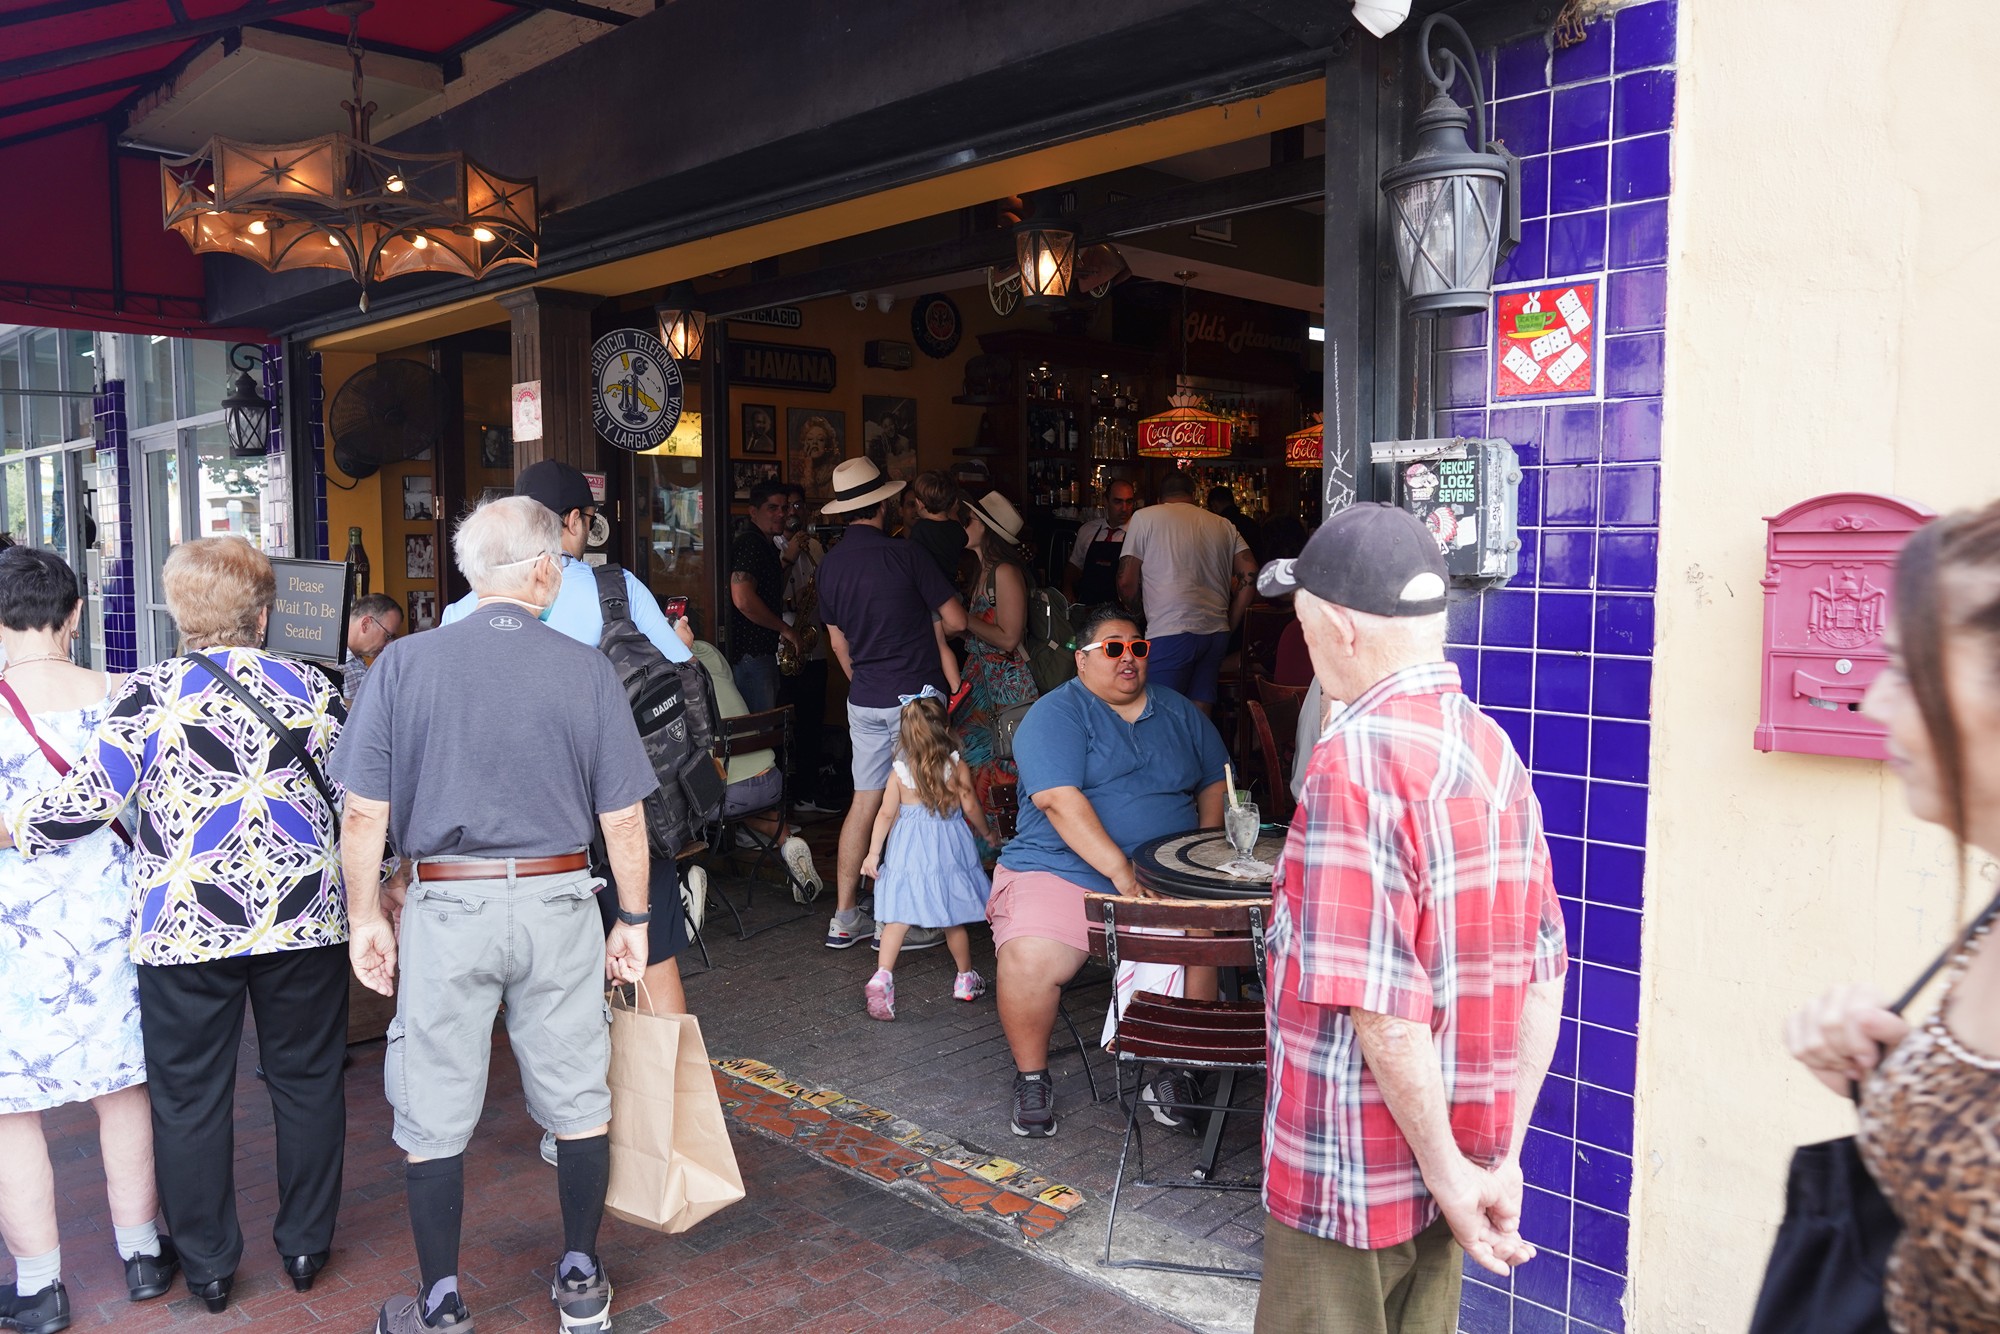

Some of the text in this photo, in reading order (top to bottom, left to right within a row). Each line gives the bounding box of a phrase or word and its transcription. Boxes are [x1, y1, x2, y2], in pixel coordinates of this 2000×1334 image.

[591, 333, 680, 386] SERVICIO TELEFONICO
[744, 349, 833, 384] HAVANA
[604, 420, 615, 434] Y
[614, 429, 650, 449] LARGA
[648, 396, 681, 445] DISTANCIA
[1440, 460, 1476, 475] REKCUF
[1440, 475, 1475, 489] LOGZ
[1438, 488, 1476, 503] SEVENS
[288, 576, 324, 594] Please
[275, 598, 336, 619] Wait To Be
[284, 622, 322, 641] Seated
[652, 694, 677, 718] DADDY
